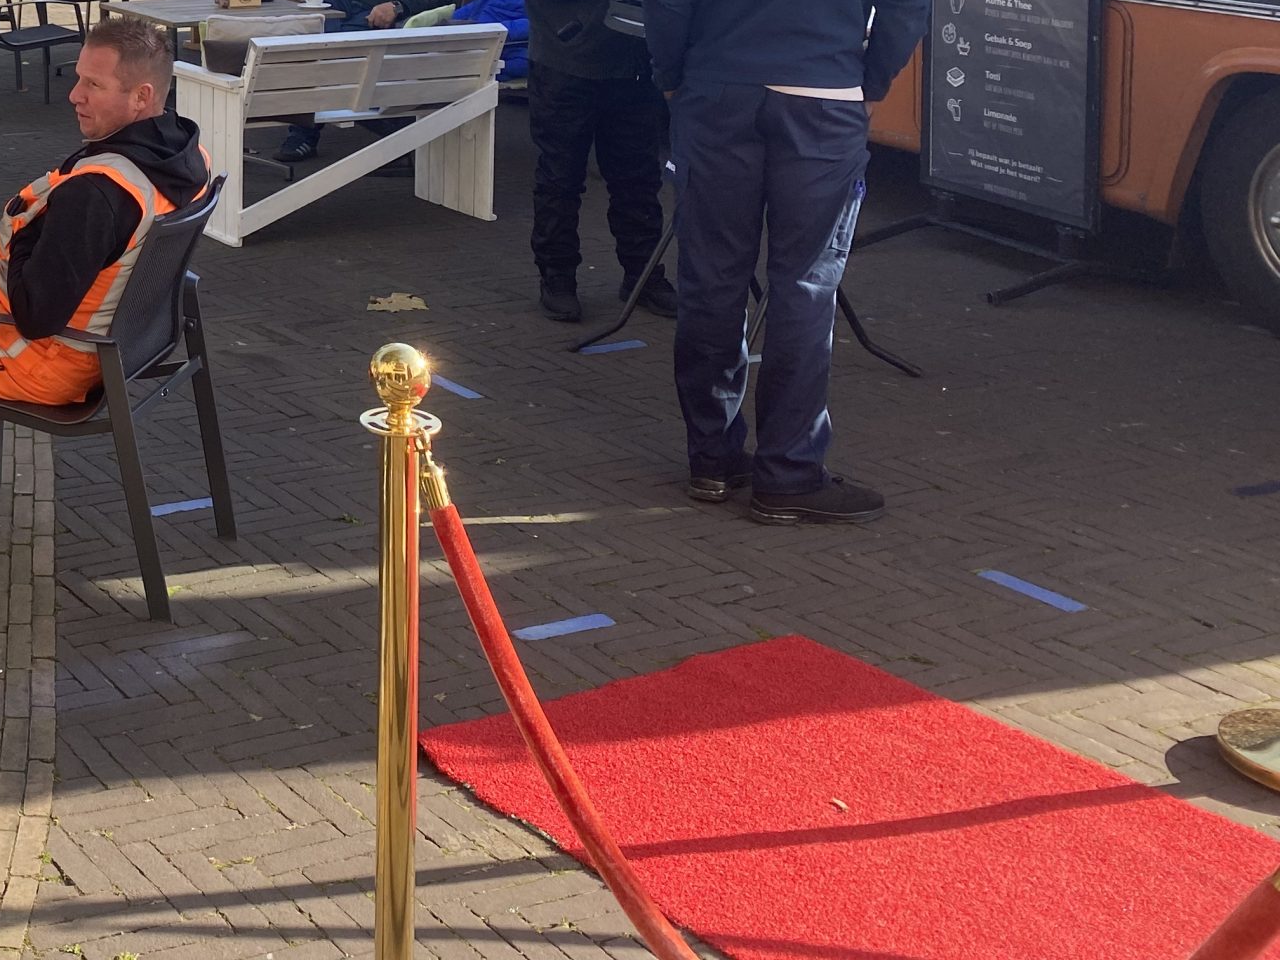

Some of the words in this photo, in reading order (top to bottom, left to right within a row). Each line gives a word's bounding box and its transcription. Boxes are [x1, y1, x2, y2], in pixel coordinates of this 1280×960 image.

[1006, 0, 1013, 8] &
[1014, 0, 1033, 11] Thee
[984, 33, 1007, 45] Gebak
[1008, 37, 1014, 46] &
[1015, 38, 1033, 50] Soep
[984, 70, 1001, 82] Tosti
[983, 107, 1018, 123] Limonade
